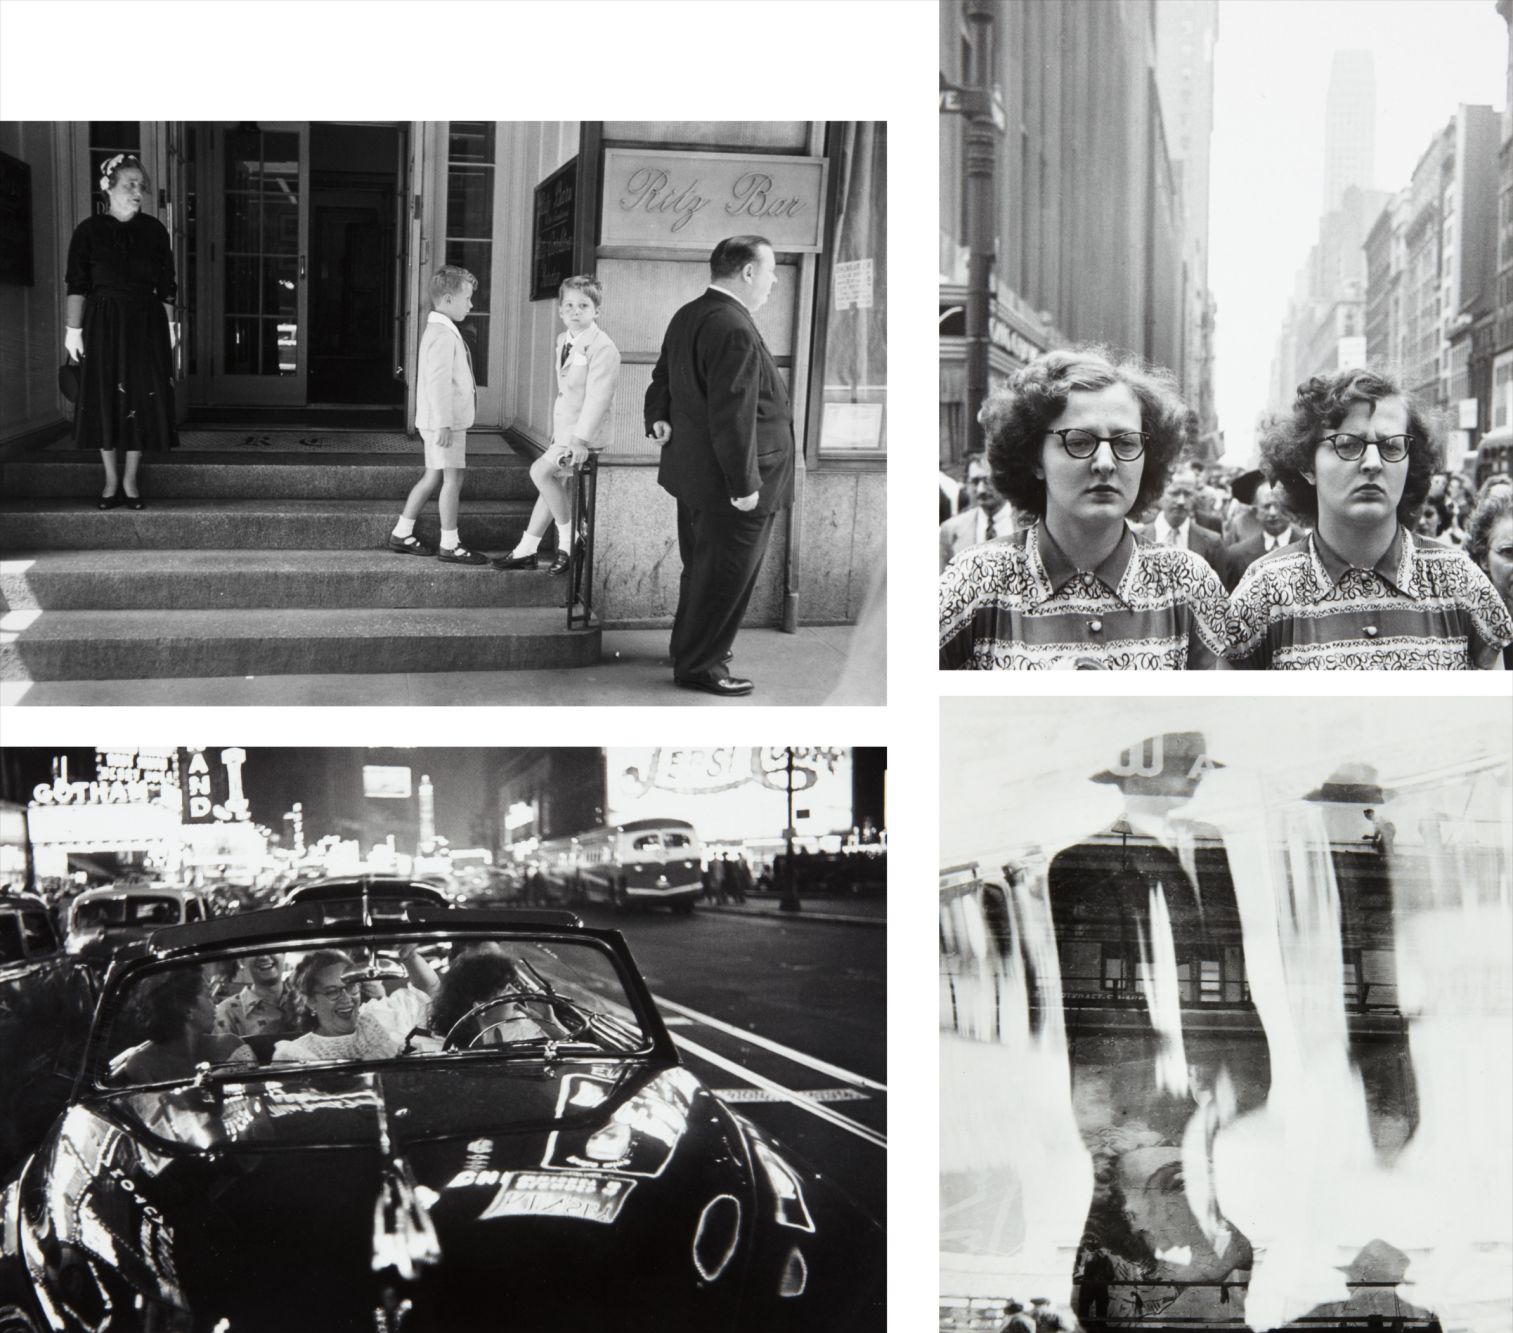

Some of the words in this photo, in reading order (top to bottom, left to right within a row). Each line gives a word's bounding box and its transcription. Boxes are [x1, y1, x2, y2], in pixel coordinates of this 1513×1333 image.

[620, 167, 712, 233] Ritz
[725, 171, 806, 217] Bar
[33, 780, 149, 804] GOTHAM
